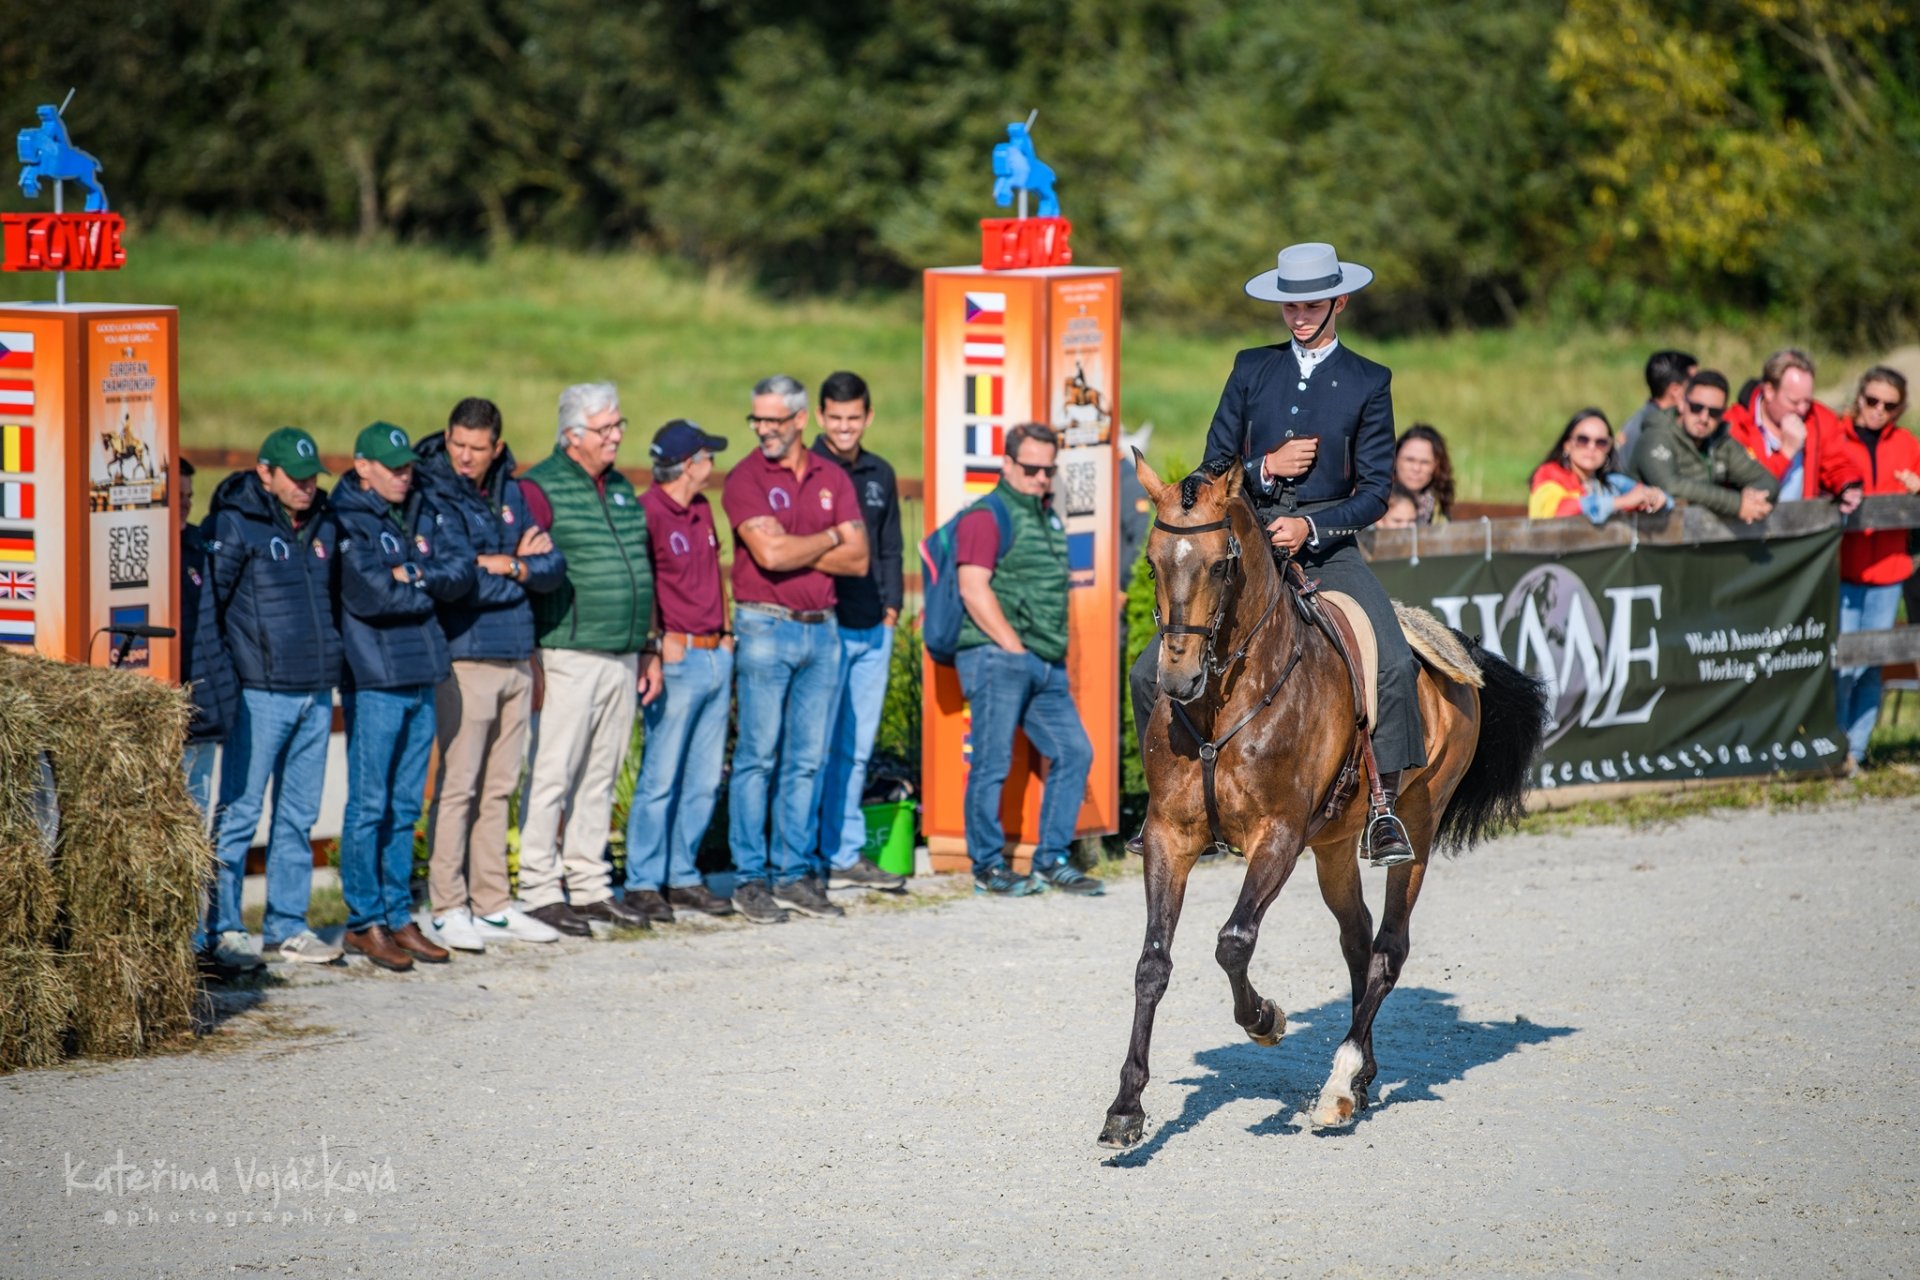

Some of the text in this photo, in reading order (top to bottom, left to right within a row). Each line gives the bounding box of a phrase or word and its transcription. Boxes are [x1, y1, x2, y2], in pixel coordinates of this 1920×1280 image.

[109, 361, 148, 377] EUROPEAN
[102, 376, 156, 393] CHAMPIONSHIP
[109, 525, 149, 545] SEVES
[109, 542, 149, 563] GLASS
[109, 559, 149, 581] BLOCK
[1684, 616, 1827, 655] World Association for
[1698, 647, 1824, 684] Working Equitation
[1539, 736, 1839, 789] gequitation.com
